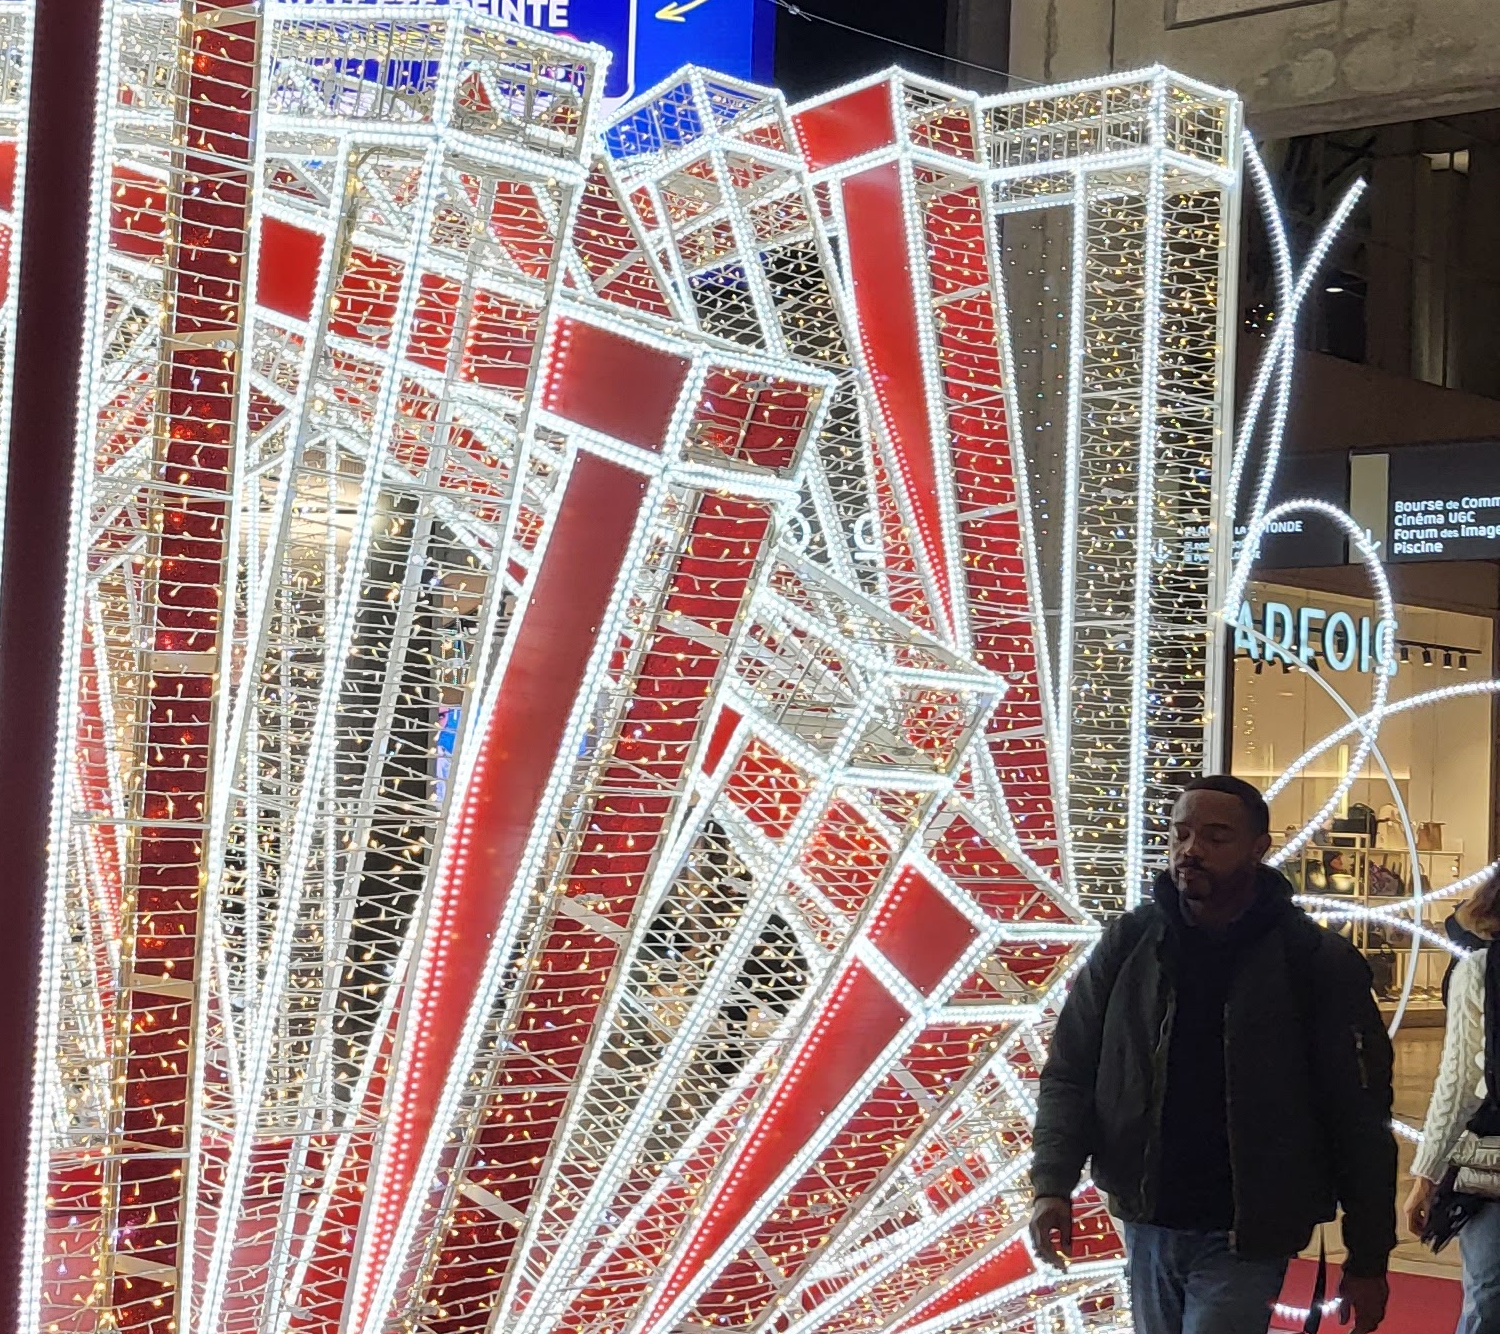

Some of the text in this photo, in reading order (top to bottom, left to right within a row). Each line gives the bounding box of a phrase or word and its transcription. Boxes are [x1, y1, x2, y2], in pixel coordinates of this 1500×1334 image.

[1394, 500, 1444, 512] Bourse
[1445, 500, 1460, 509] de
[1394, 511, 1476, 526] Cinéma UGC
[1393, 528, 1439, 540] Forum
[1440, 529, 1460, 538] des
[1393, 540, 1444, 554] Piscine
[1234, 600, 1399, 676] ARFOIS
